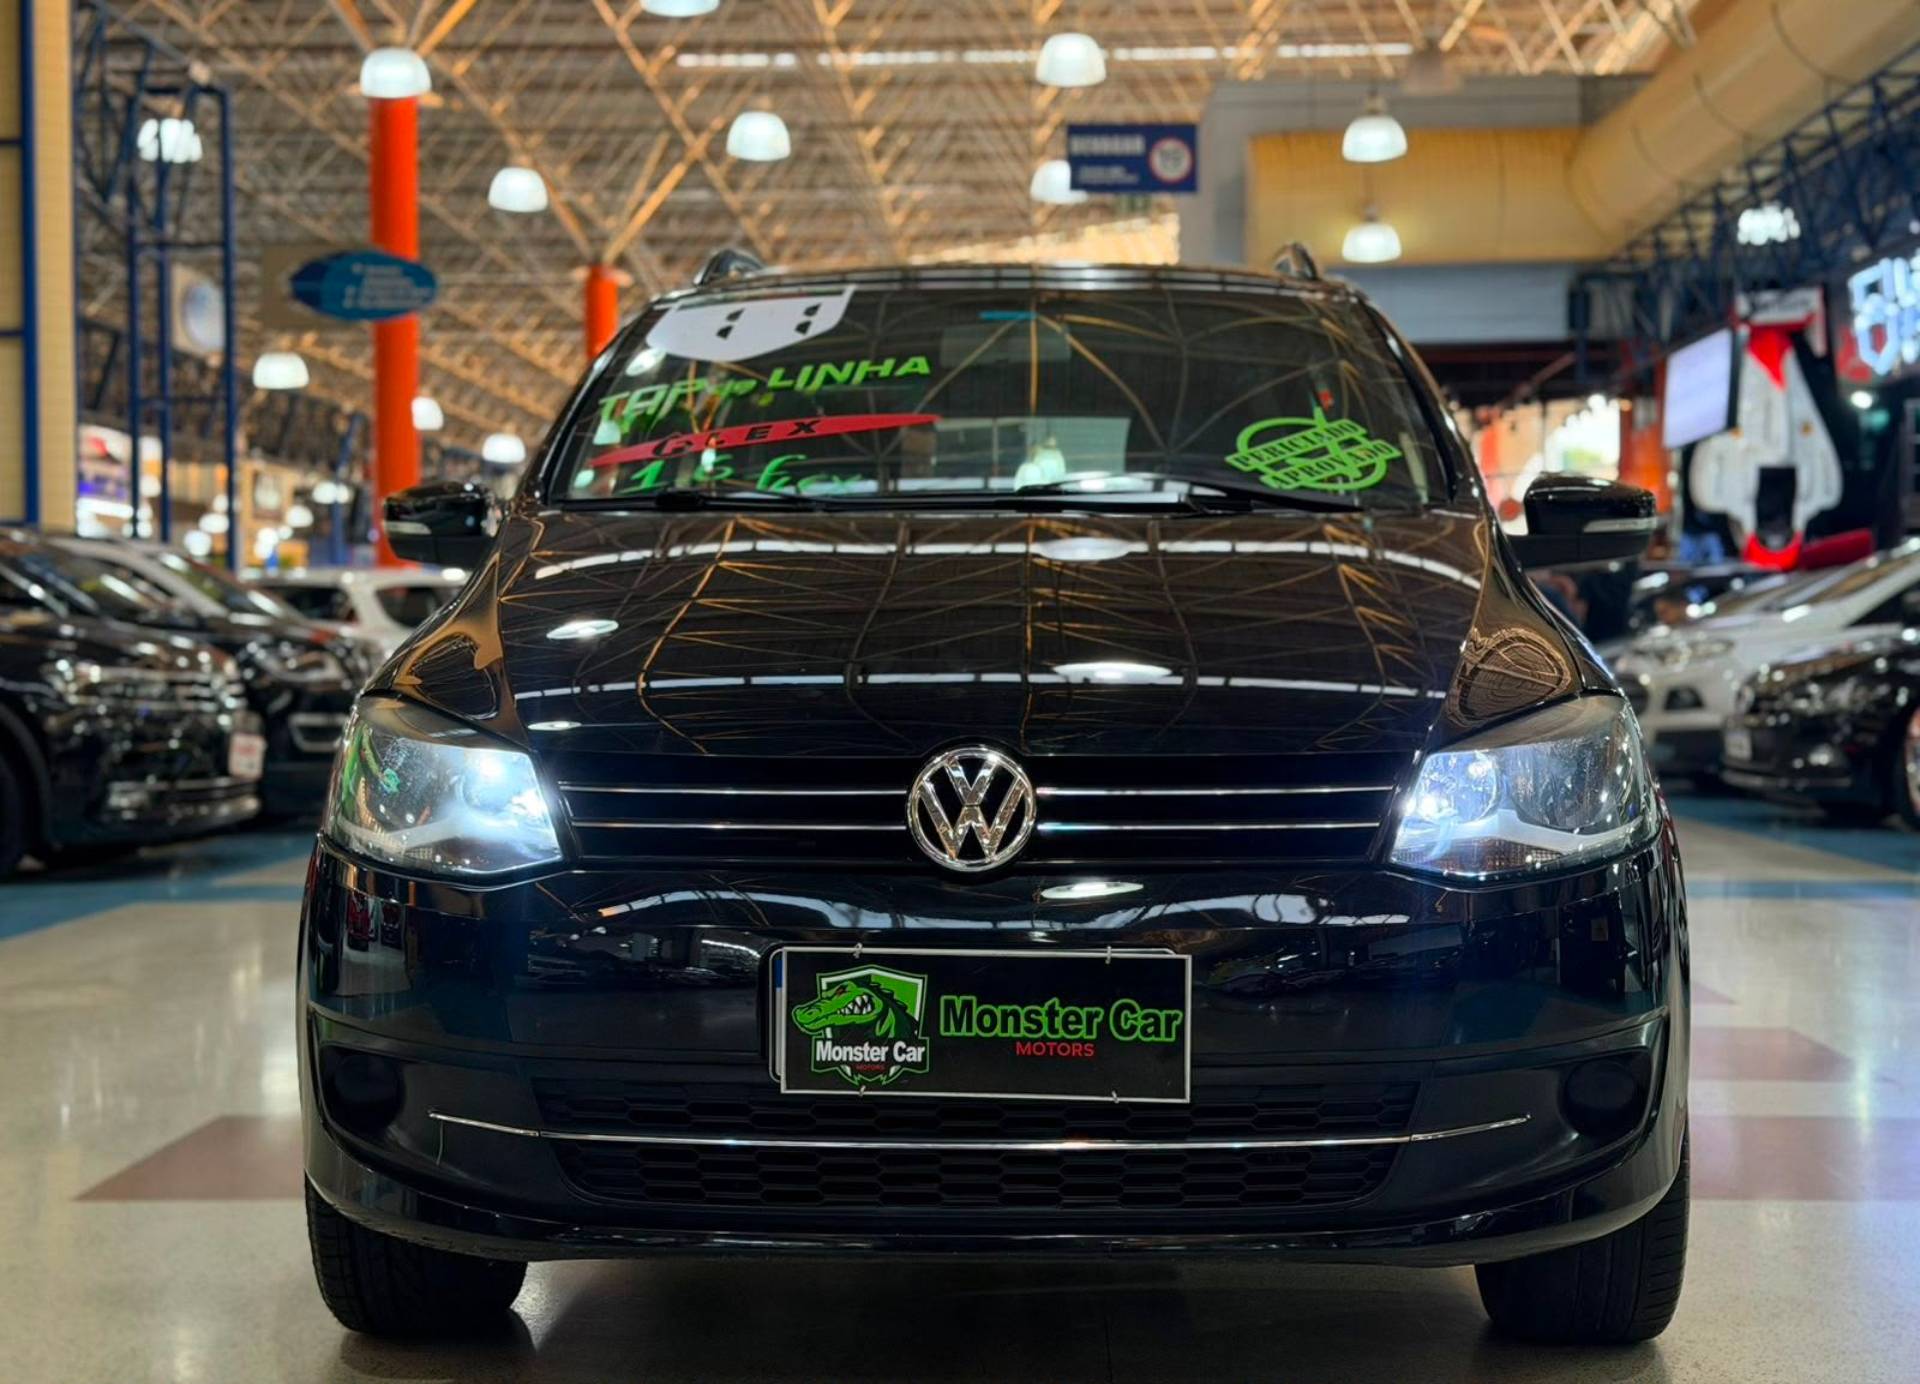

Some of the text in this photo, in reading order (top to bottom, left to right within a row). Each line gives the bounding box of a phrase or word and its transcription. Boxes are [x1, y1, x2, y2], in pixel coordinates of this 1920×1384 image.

[766, 356, 931, 390] LINHA
[1232, 420, 1361, 467] PERICIADO
[1269, 442, 1393, 487] APROVADO
[940, 995, 1182, 1042] Monster Car
[816, 1040, 925, 1063] Monster Car
[1016, 1041, 1095, 1057] MOTORS
